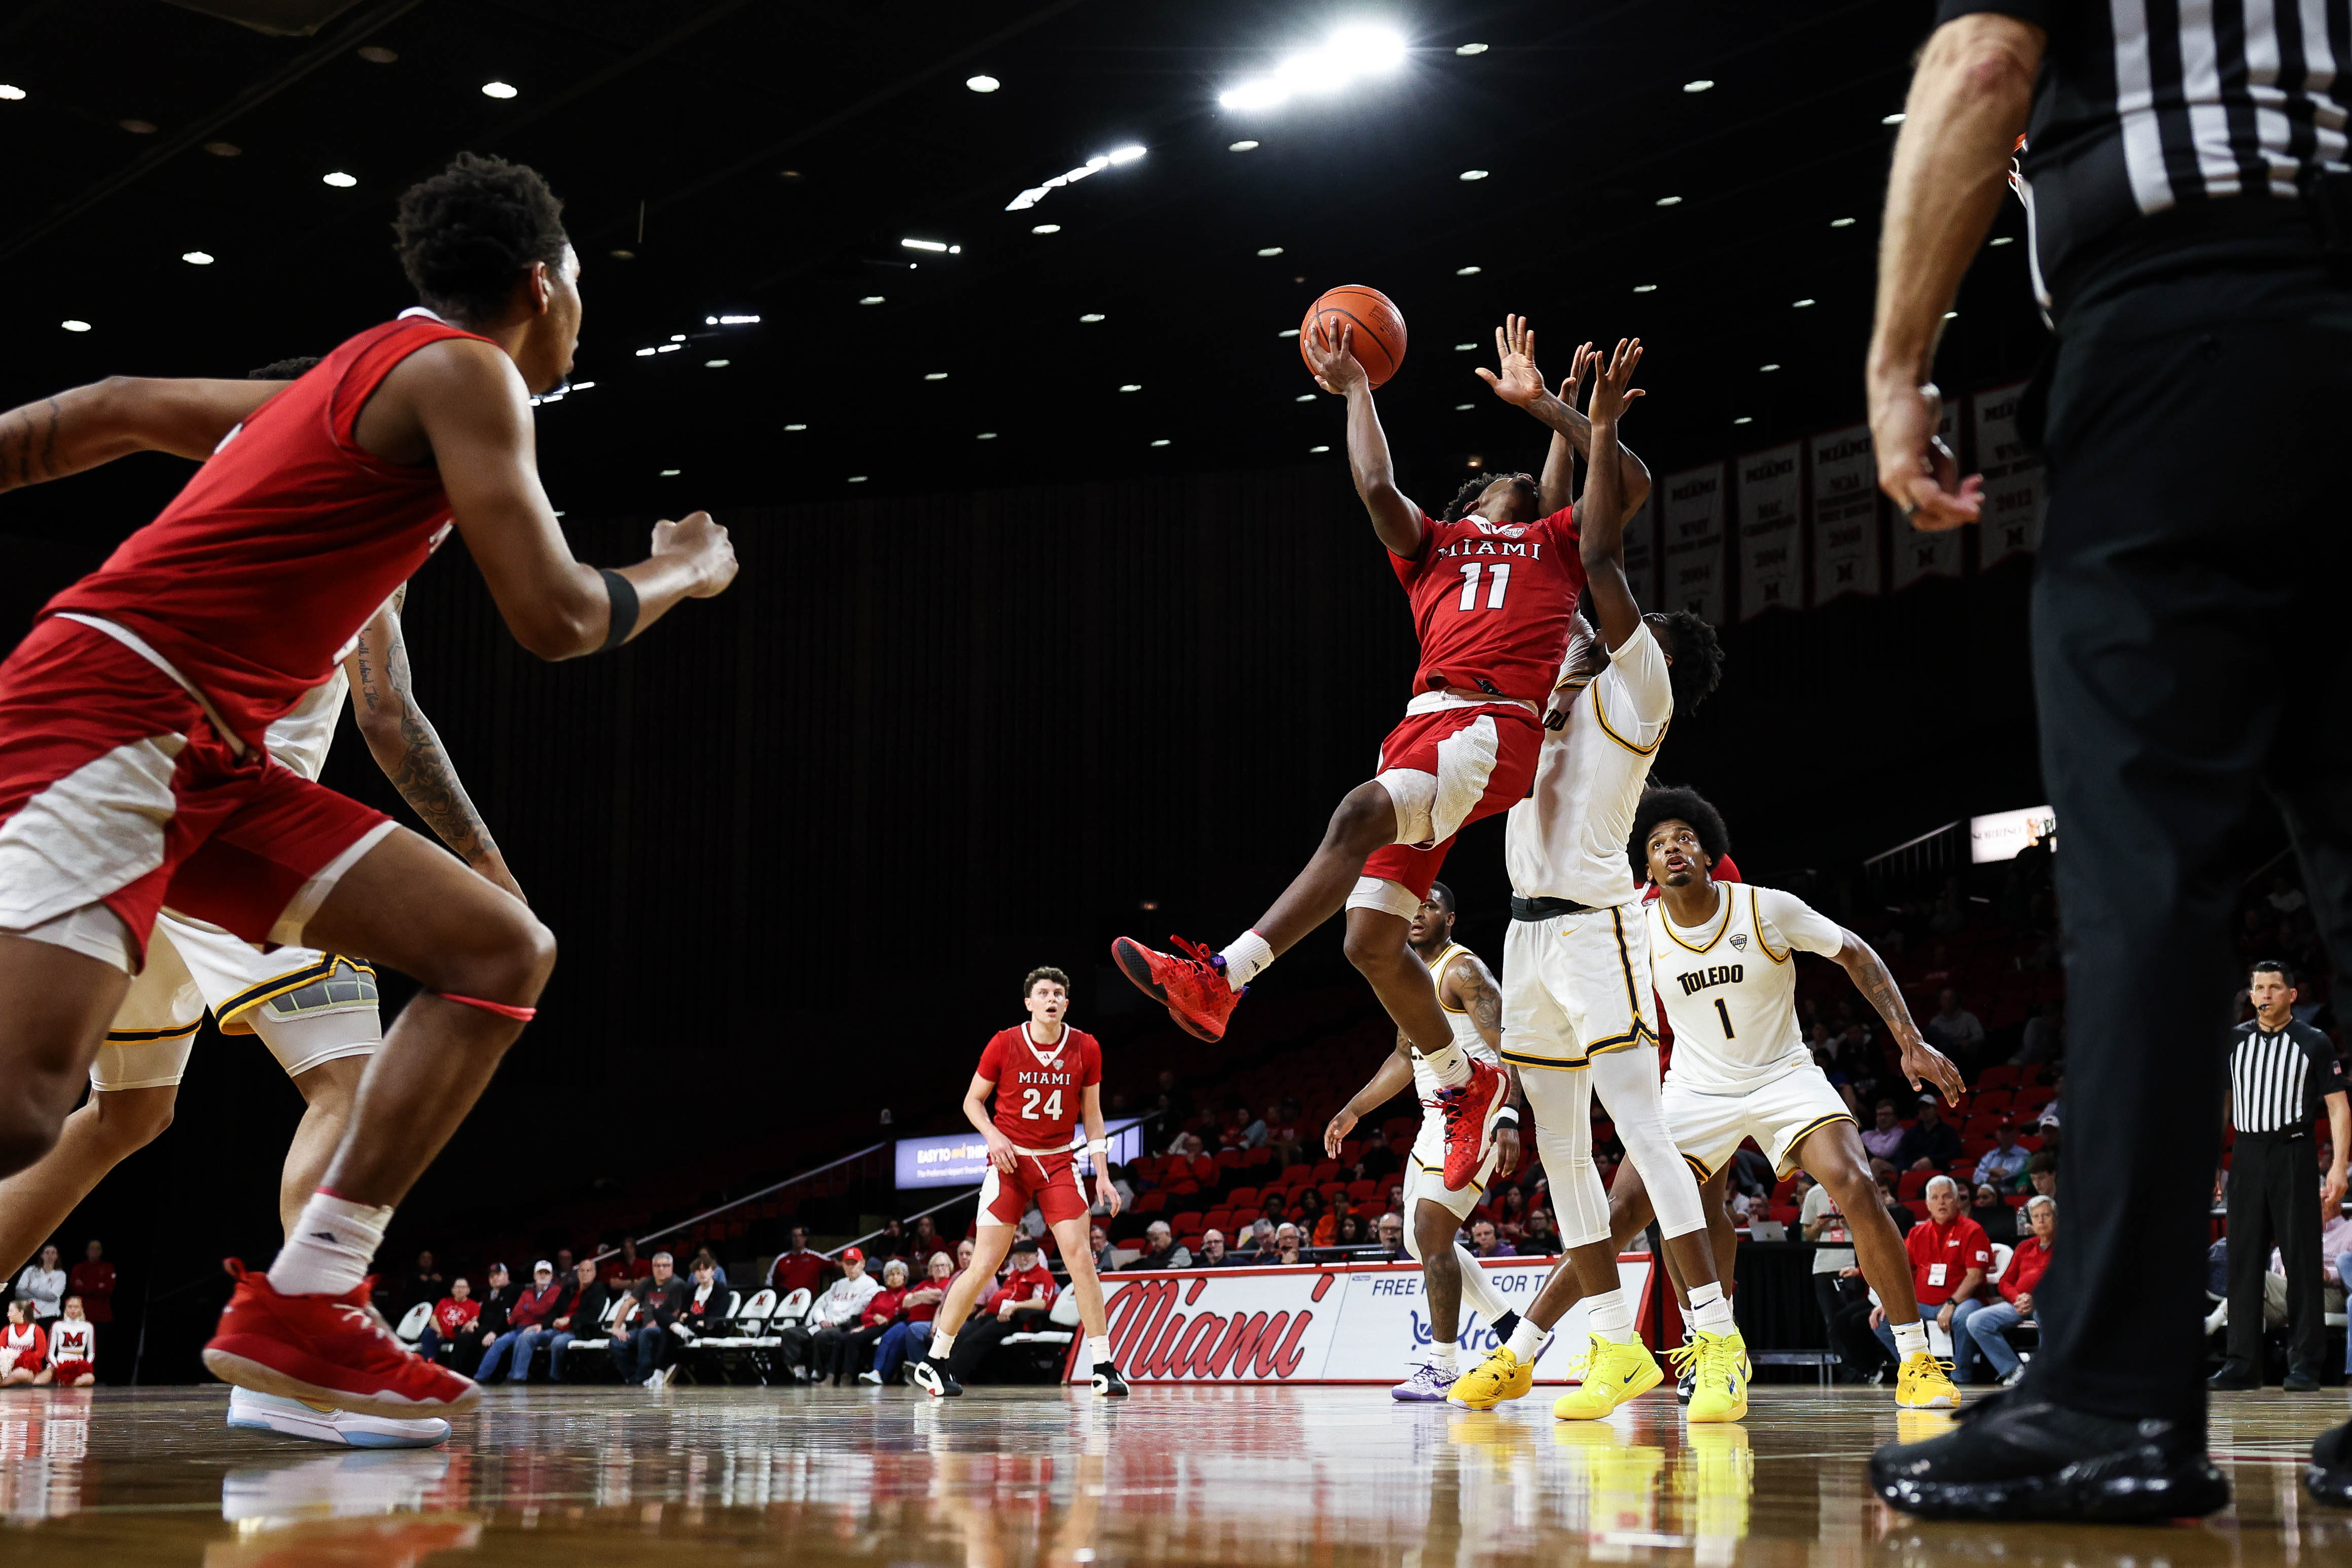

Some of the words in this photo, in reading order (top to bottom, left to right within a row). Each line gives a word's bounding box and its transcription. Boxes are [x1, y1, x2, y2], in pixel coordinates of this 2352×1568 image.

[1985, 403, 2016, 422] MIA
[1819, 438, 1871, 465] MIAMI
[1745, 459, 1793, 484] MIAMI
[1672, 479, 1716, 502] MIAMI
[1437, 539, 1542, 561] MIAMI
[1458, 561, 1511, 612] 11
[1677, 965, 1743, 996] TOLEDO
[1715, 998, 1734, 1040] 1
[1018, 1071, 1071, 1086] MIAMI
[1021, 1087, 1063, 1121] 24
[917, 1148, 938, 1164] EASY
[937, 1147, 951, 1162] TO
[966, 1143, 989, 1160] THRO
[1372, 1278, 1417, 1296] FREE
[1492, 1275, 1528, 1293] FOR
[1107, 1272, 1336, 1381] Miami
[62, 1331, 85, 1347] M
